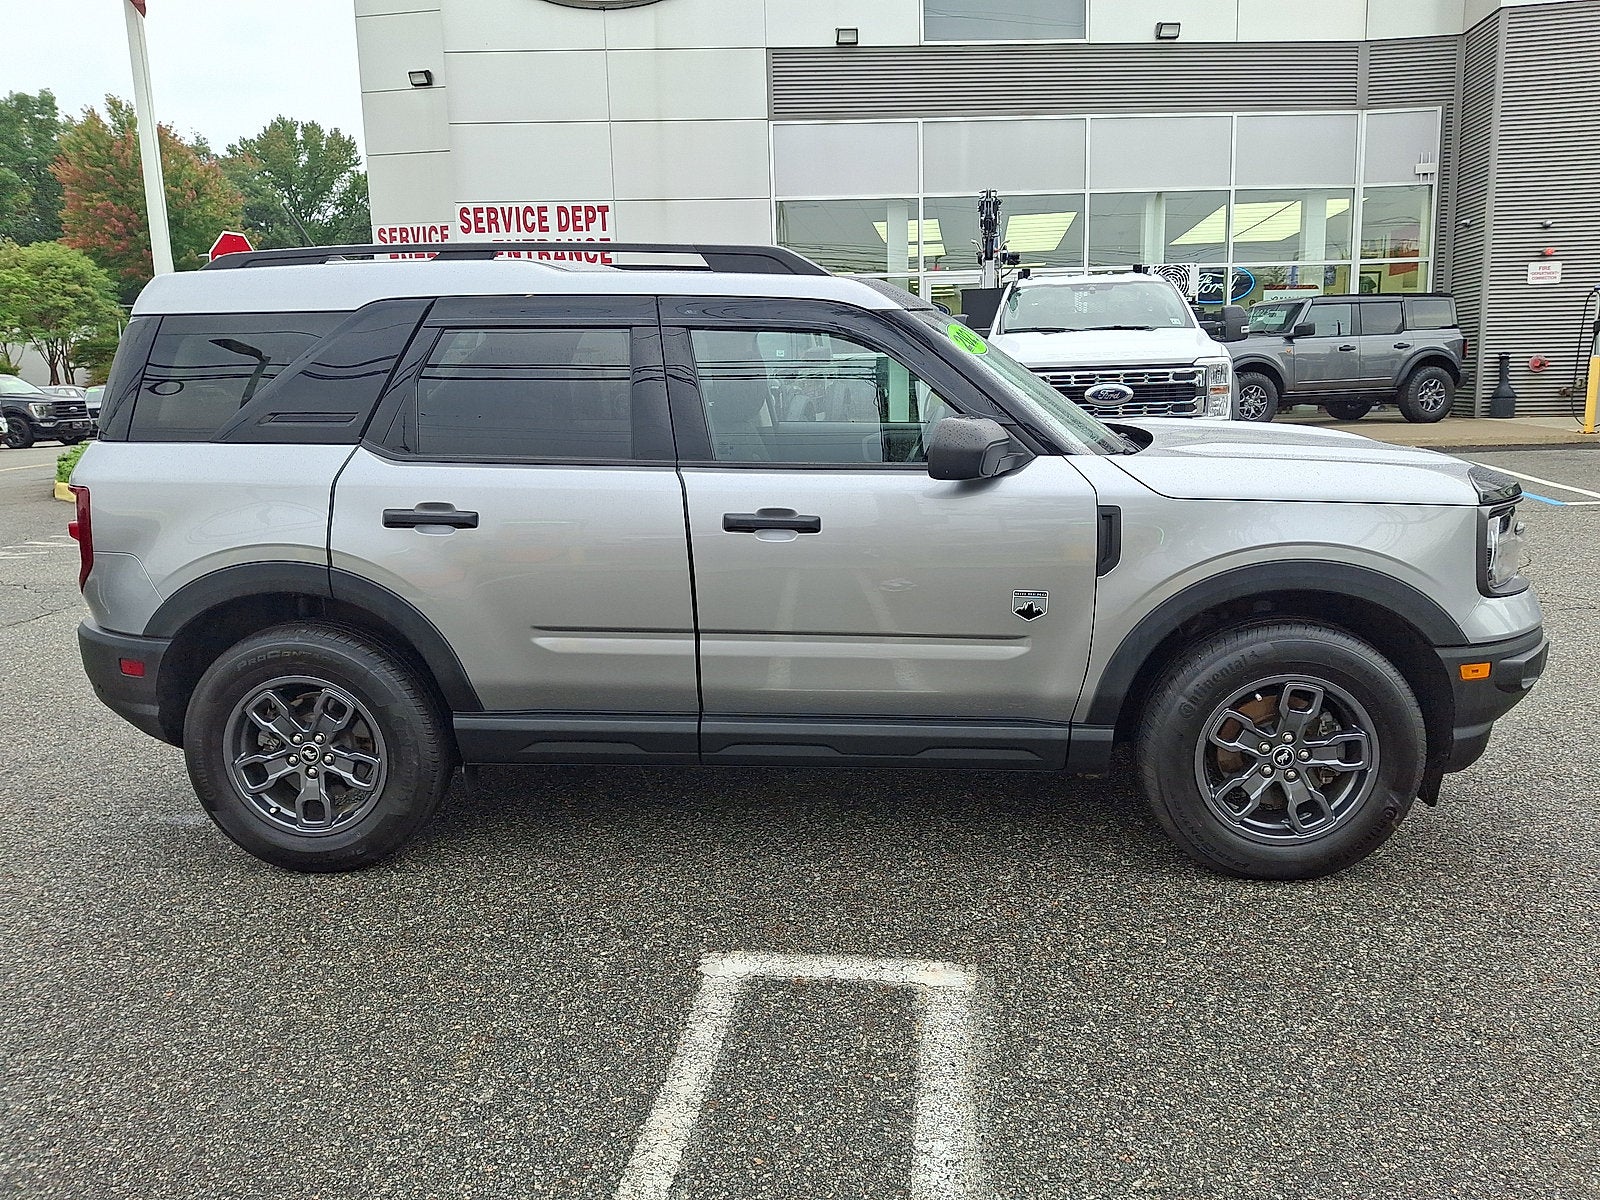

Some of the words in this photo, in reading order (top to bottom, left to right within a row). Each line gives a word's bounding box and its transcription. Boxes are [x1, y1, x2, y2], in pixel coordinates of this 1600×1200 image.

[459, 205, 550, 235] SERVICE
[557, 205, 610, 232] DEPT
[377, 225, 449, 244] SERVICE
[1097, 388, 1121, 401] Ford
